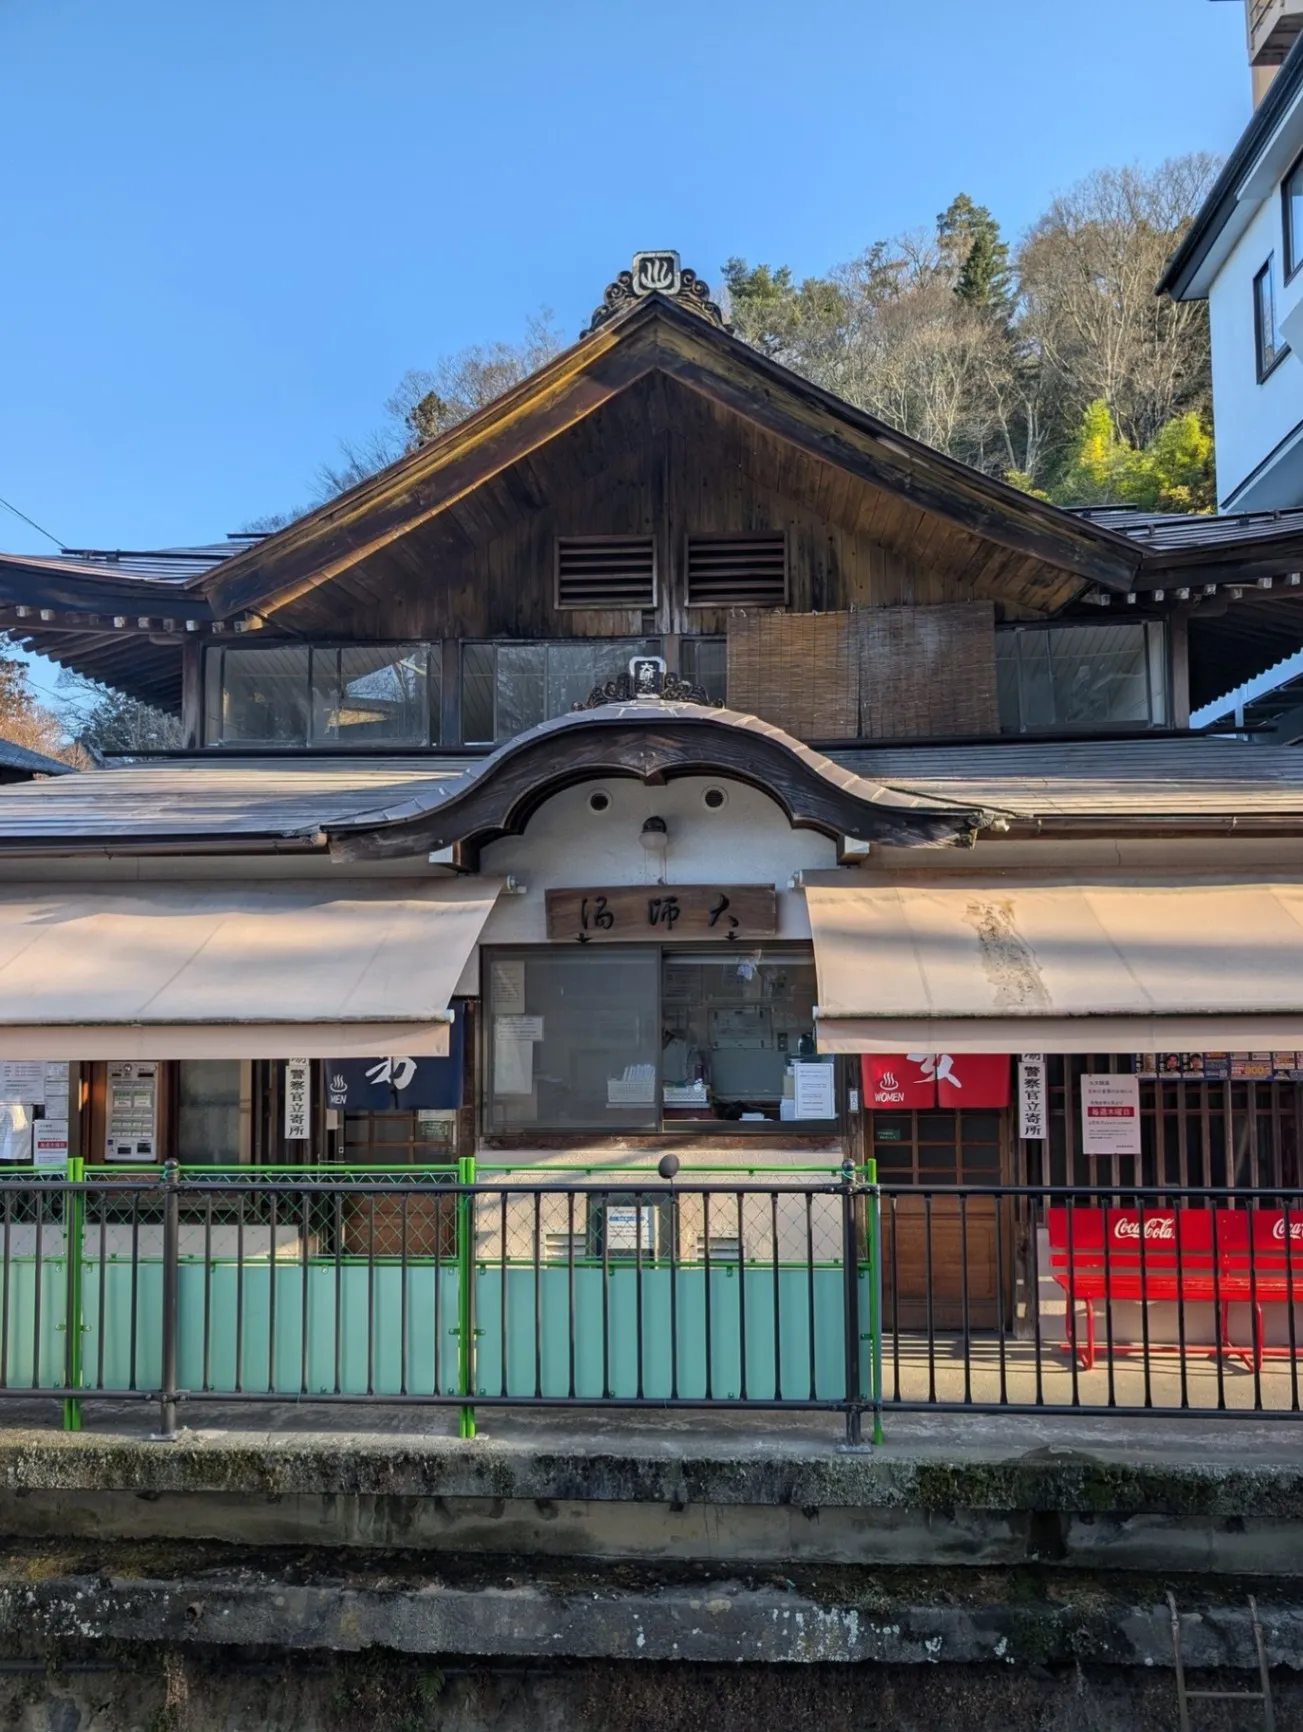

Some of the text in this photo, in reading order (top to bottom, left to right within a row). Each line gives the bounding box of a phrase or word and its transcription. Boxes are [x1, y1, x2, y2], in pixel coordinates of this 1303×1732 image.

[289, 1069, 305, 1136] 警察官立寄所
[330, 1094, 347, 1104] MEN
[874, 1092, 905, 1102] WOMEN
[1023, 1066, 1042, 1136] 警察官立寄所
[1114, 1217, 1175, 1239] CocaCola
